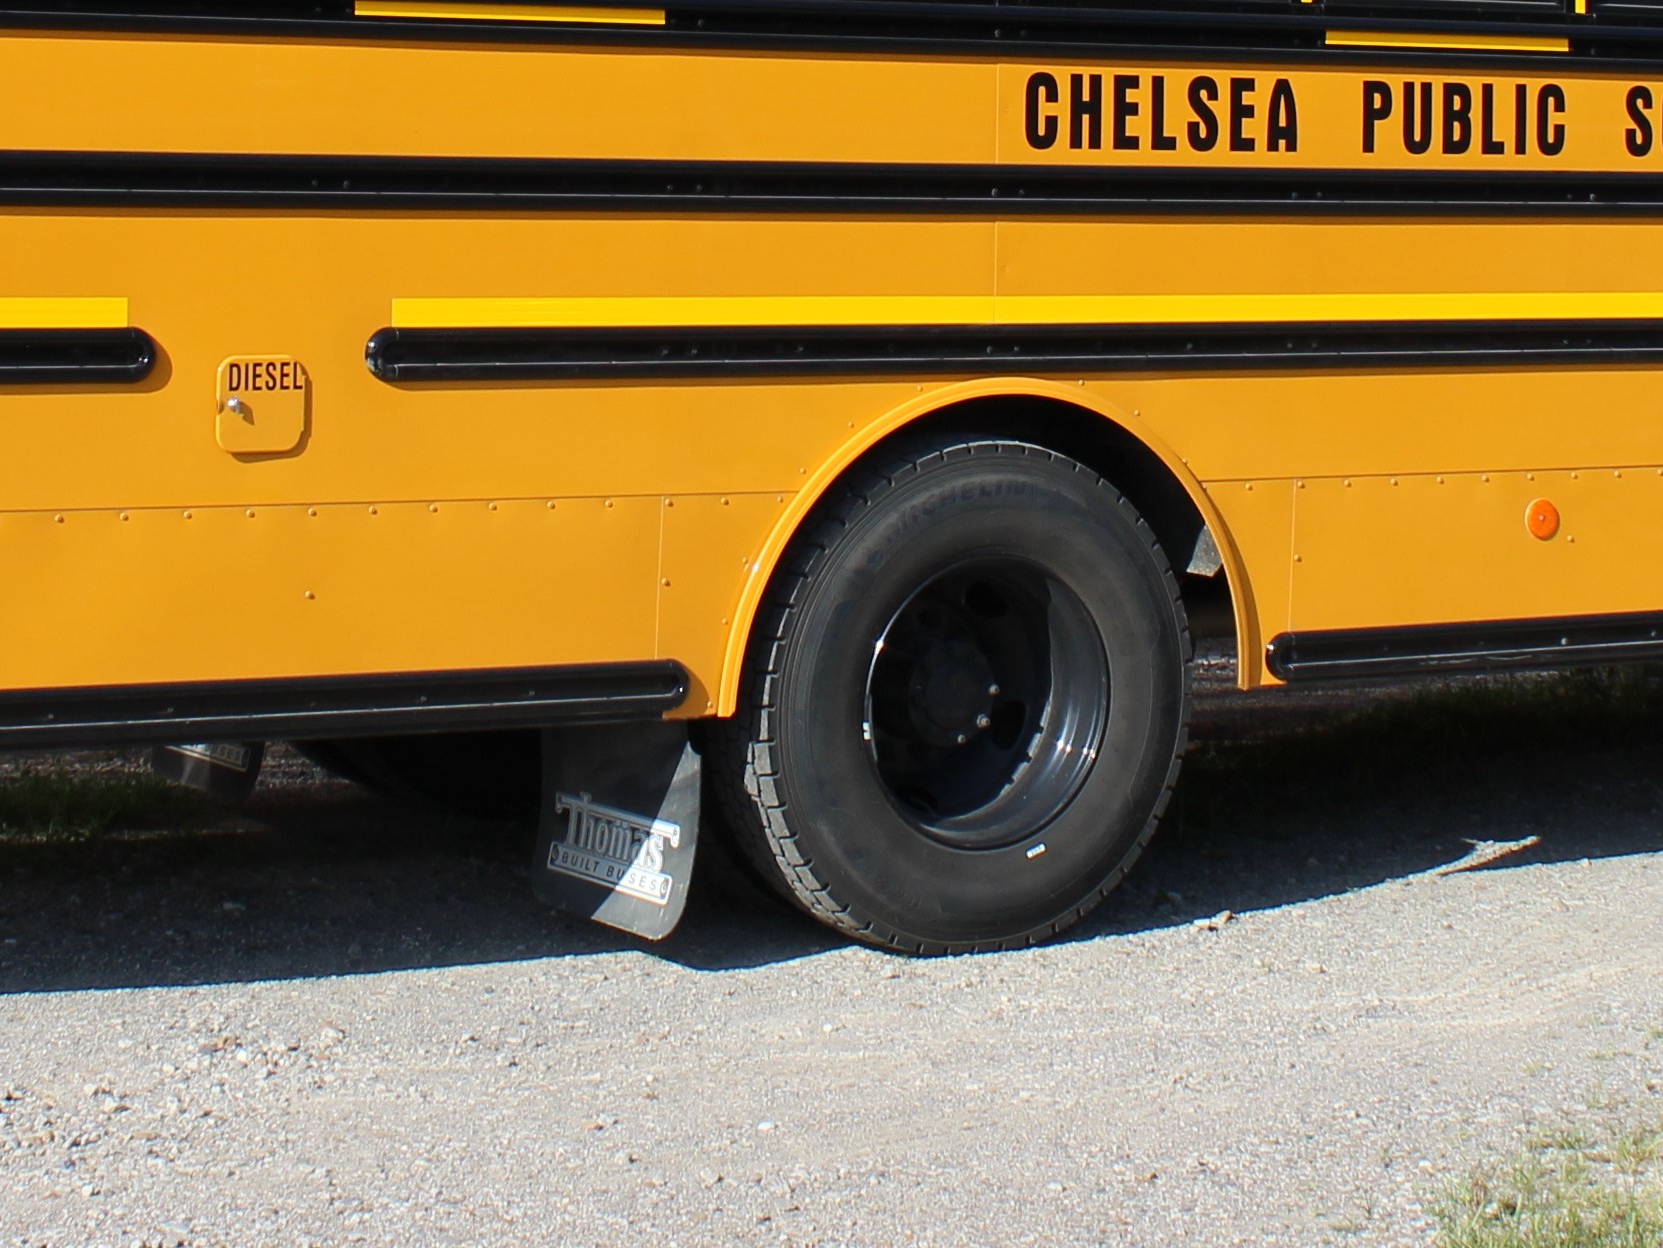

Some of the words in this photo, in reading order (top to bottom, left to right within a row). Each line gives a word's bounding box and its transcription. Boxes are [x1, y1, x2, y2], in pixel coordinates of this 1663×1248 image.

[1025, 72, 1298, 152] CHELSEA
[1362, 80, 1566, 156] PUBLIC
[229, 361, 304, 391] DIESEL
[555, 791, 681, 874] Thomas
[561, 852, 600, 872] BUILT
[606, 865, 657, 892] BUSES
